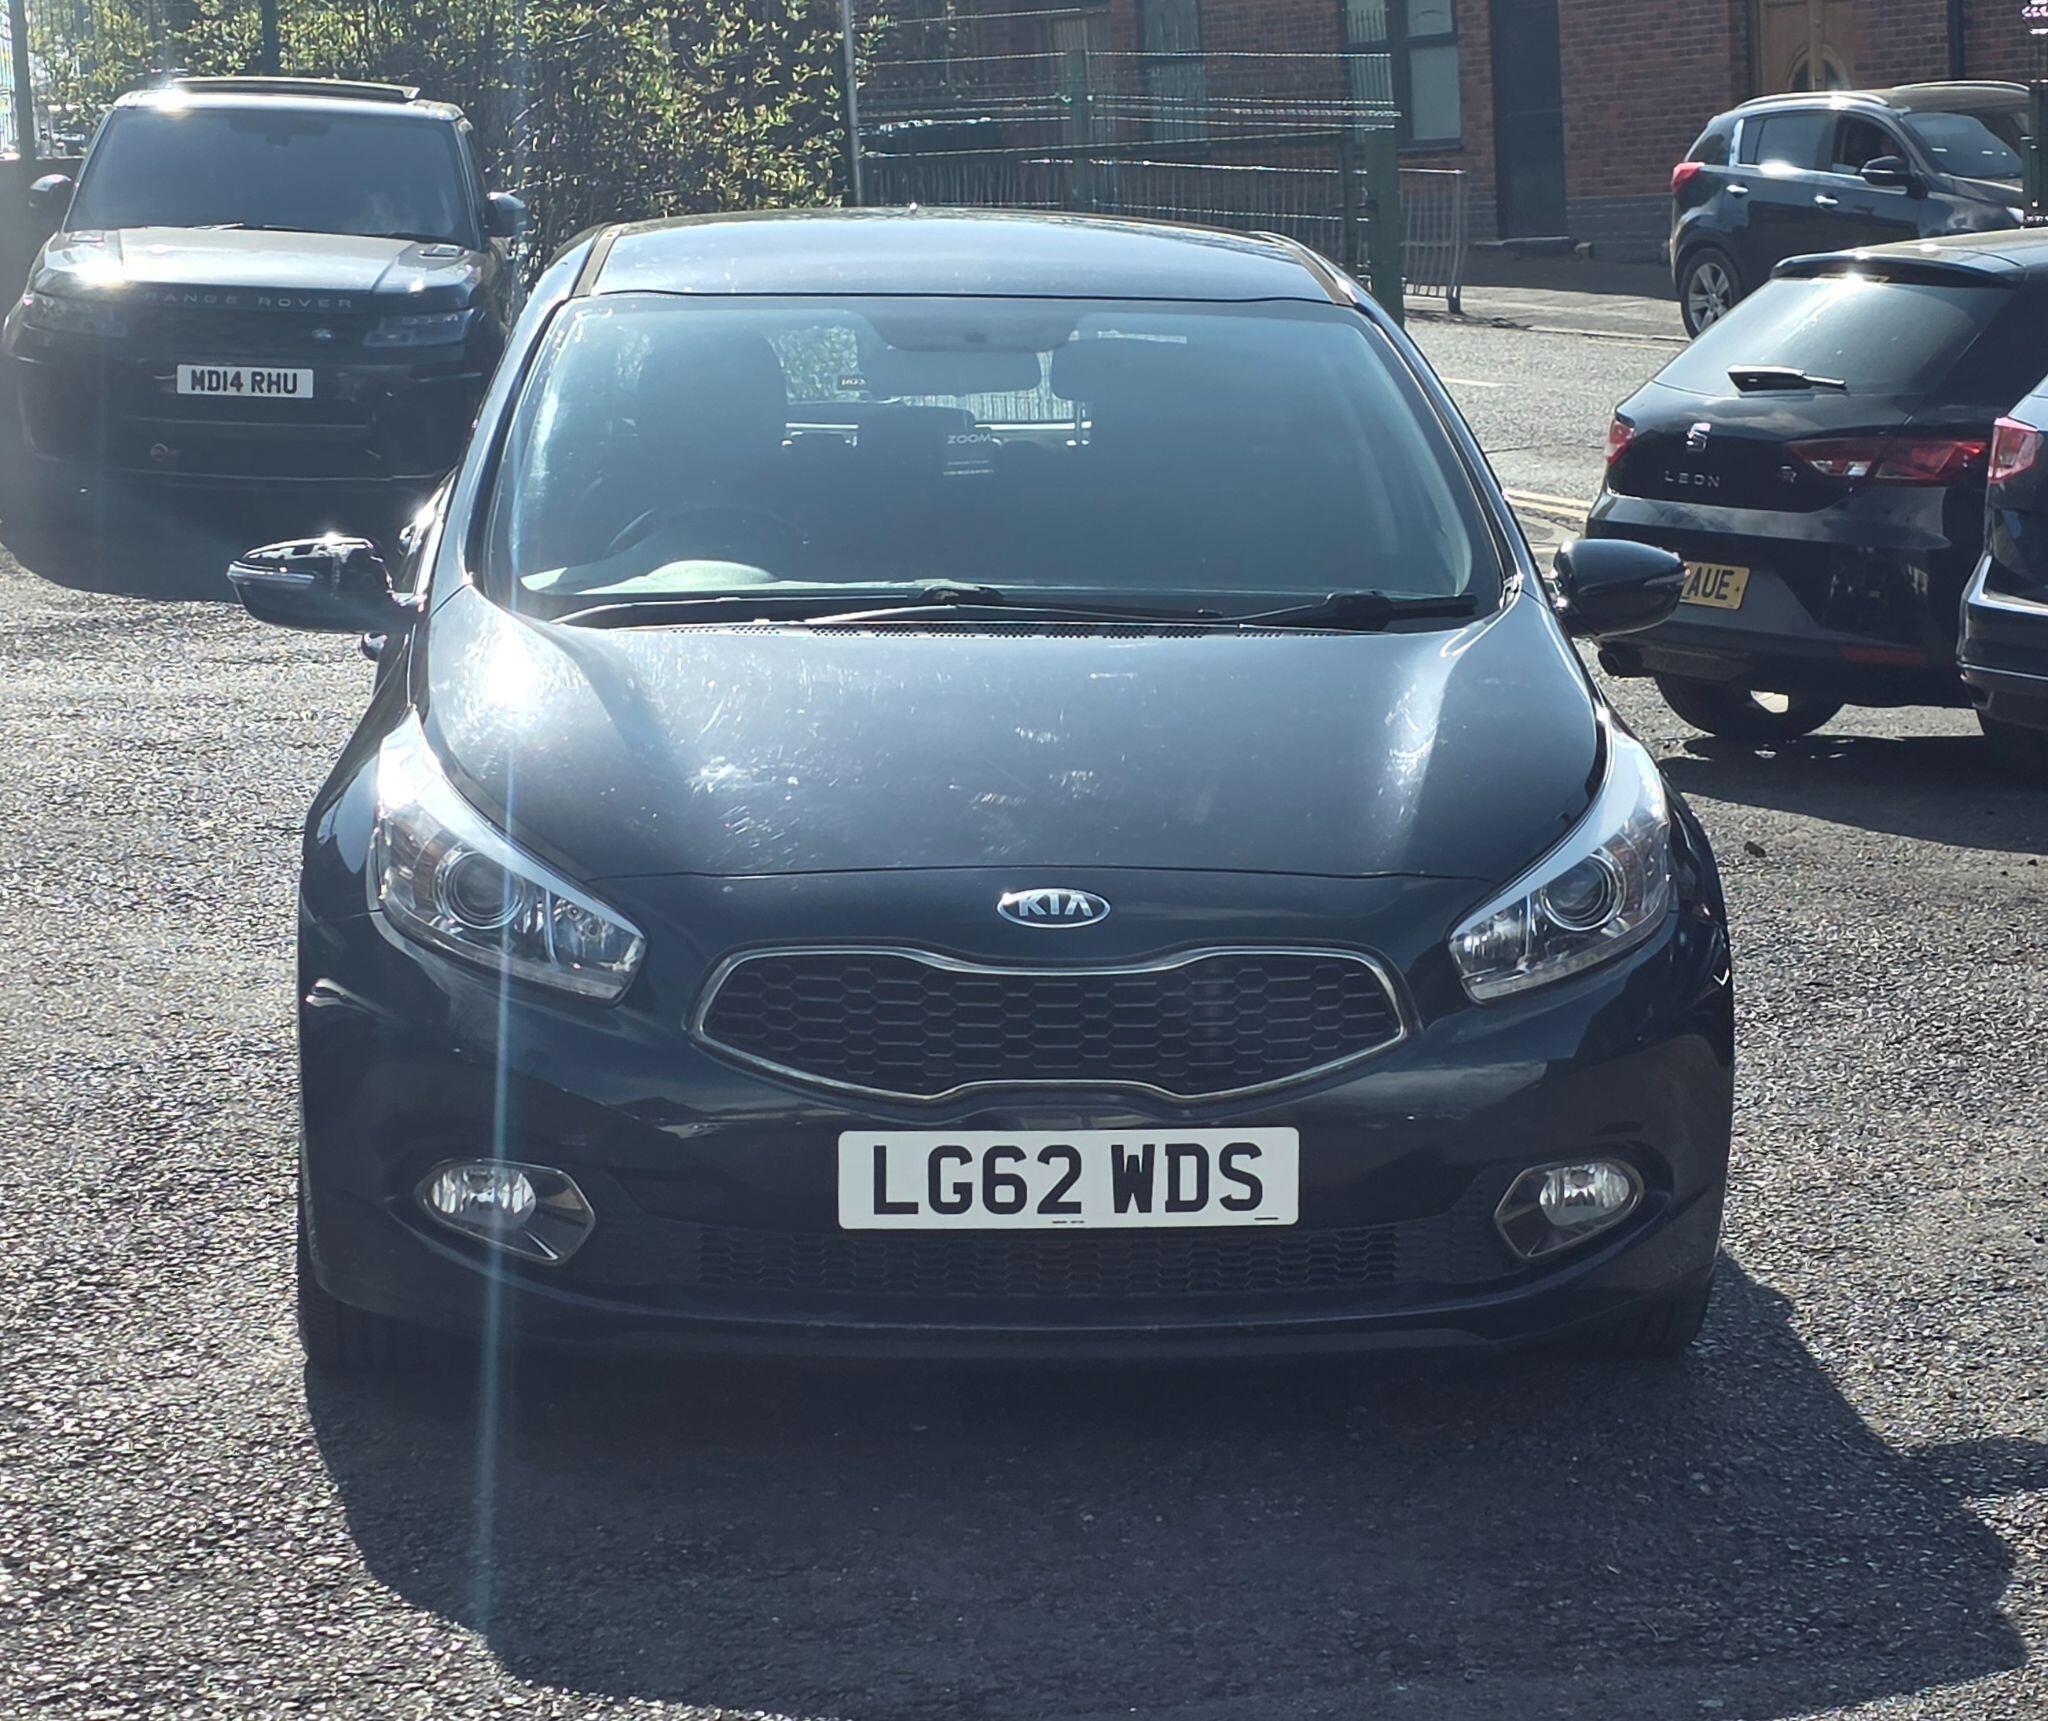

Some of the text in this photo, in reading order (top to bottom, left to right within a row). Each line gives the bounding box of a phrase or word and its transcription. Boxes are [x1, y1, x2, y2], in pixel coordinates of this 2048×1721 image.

[257, 296, 352, 308] ROVER
[191, 369, 298, 394] MD14 RHU
[947, 433, 991, 444] ZOOM
[1664, 470, 1720, 487] LEON
[1686, 566, 1735, 600] AUE
[1018, 892, 1094, 917] KIA
[873, 1142, 1264, 1216] LG62 WDS
